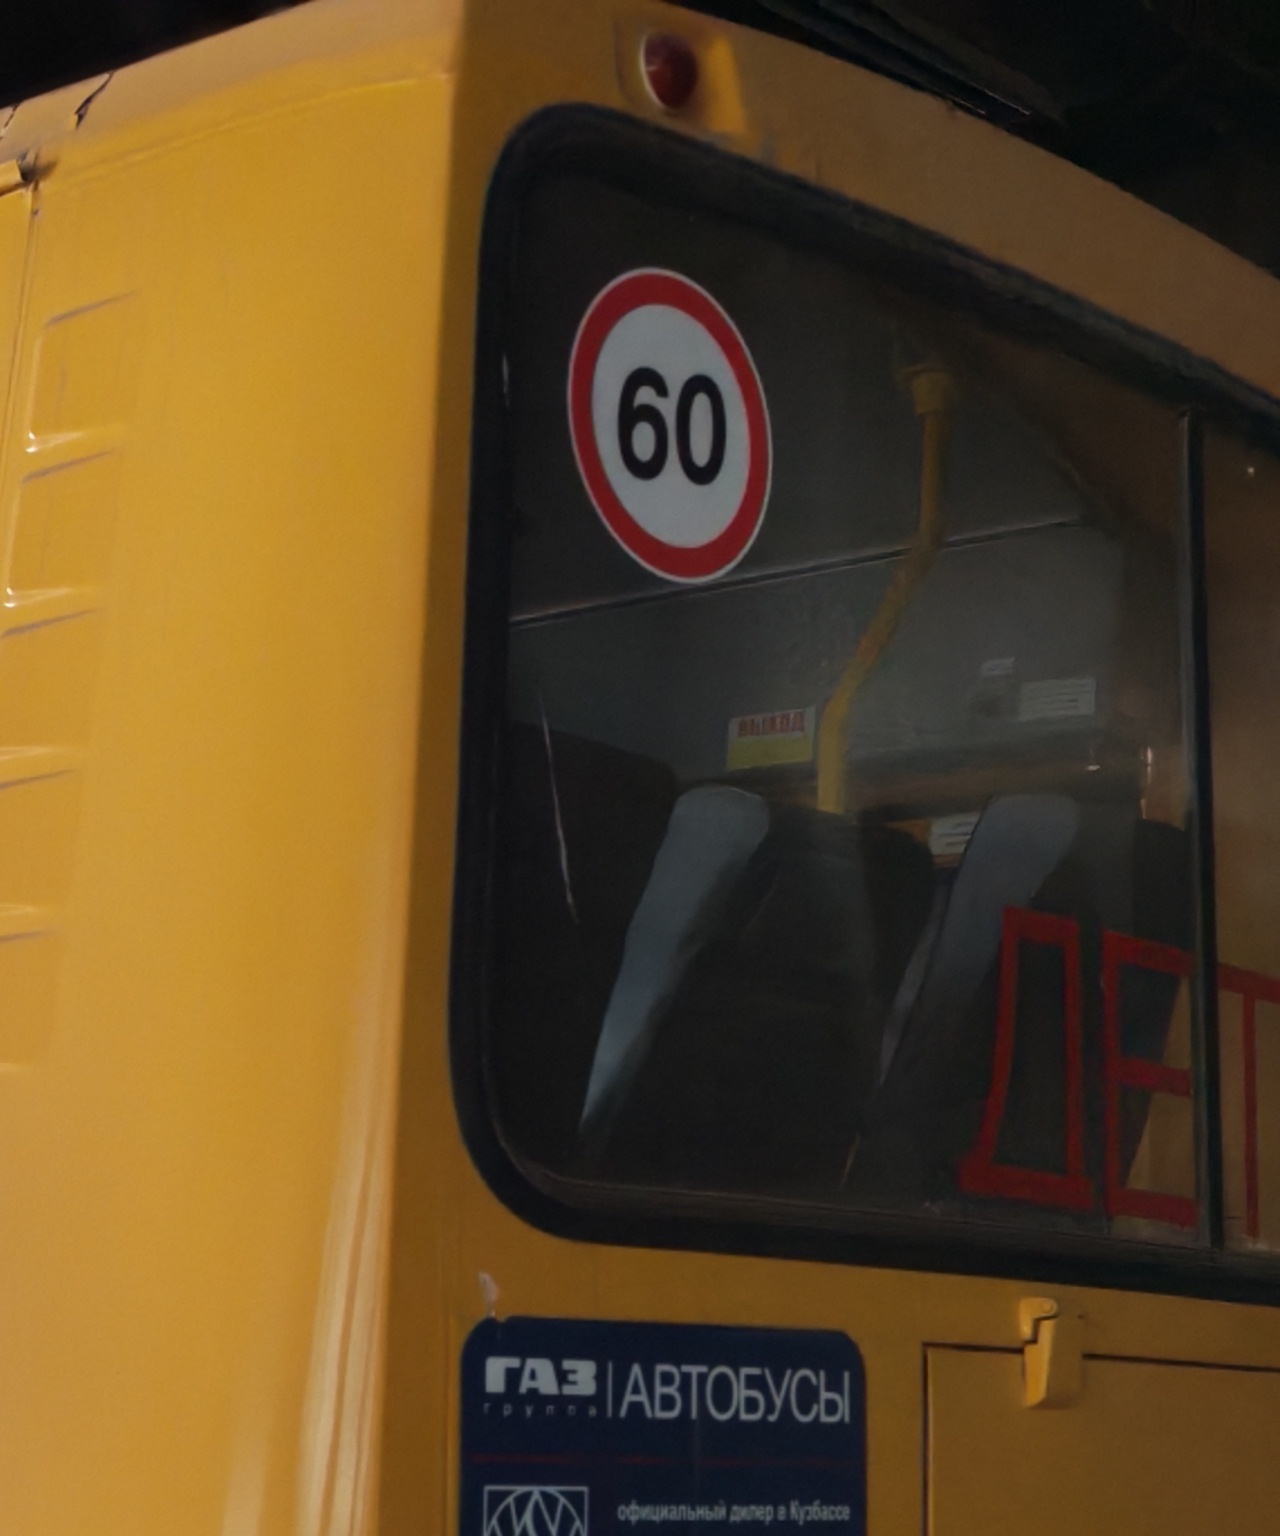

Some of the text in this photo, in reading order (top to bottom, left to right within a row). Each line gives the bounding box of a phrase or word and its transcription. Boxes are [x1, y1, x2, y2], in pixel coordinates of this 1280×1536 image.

[617, 366, 727, 486] 60
[484, 1356, 851, 1424] ГАЗ АВТОБУСЫ
[617, 1500, 727, 1526] официальный
[728, 1502, 774, 1526] дилер
[790, 1500, 851, 1526] Кузбассе
